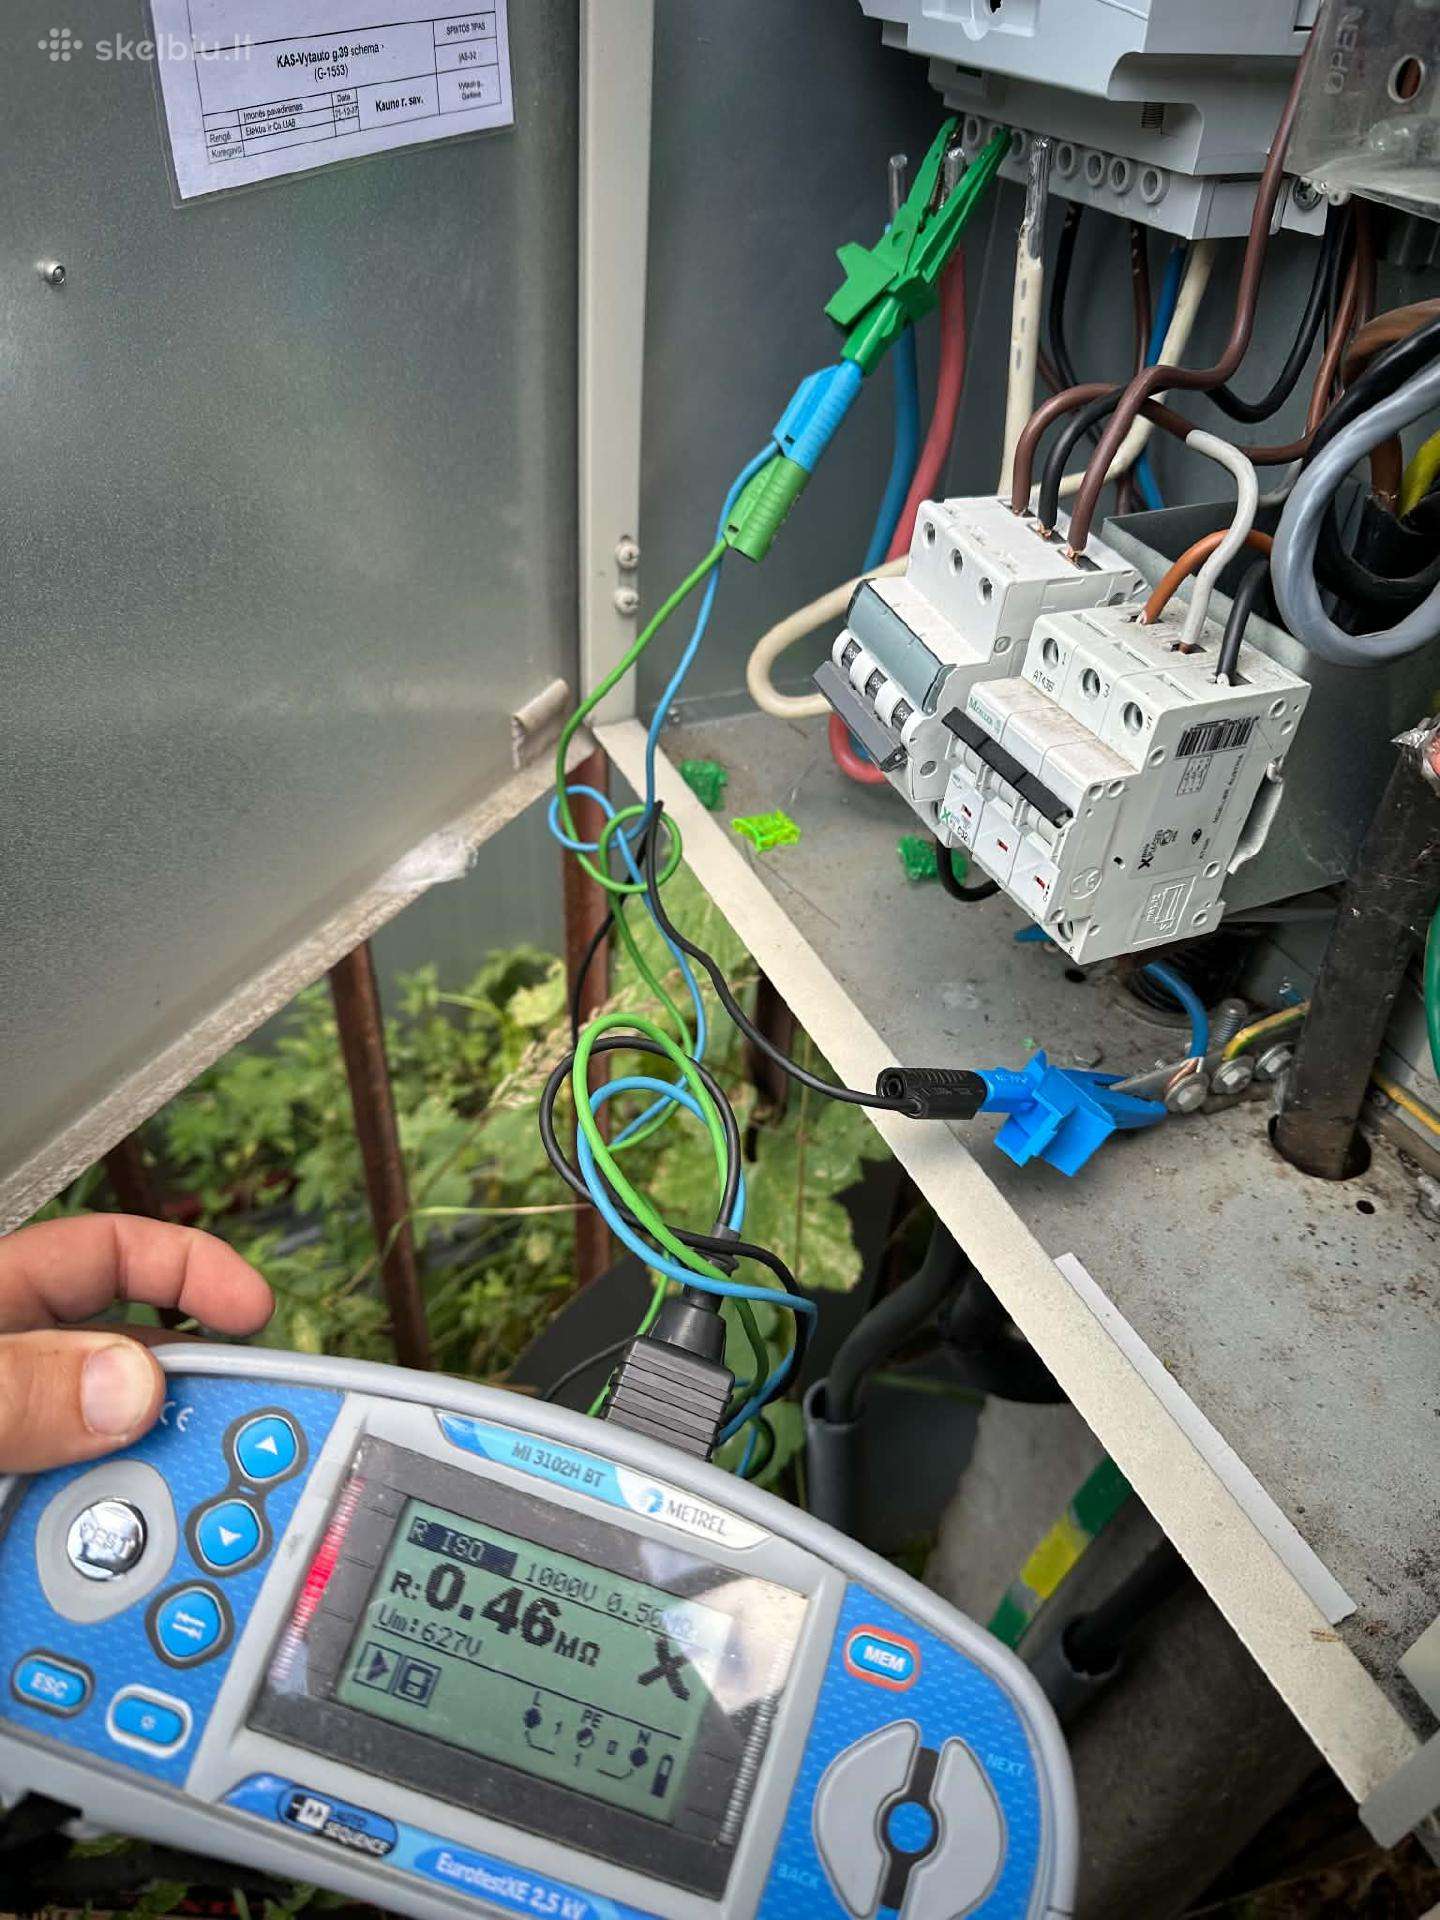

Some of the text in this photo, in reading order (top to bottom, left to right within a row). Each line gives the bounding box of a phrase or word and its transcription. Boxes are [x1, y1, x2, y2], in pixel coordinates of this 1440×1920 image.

[276, 51, 331, 68] KAS-Vytauto
[350, 43, 380, 56] schema
[314, 63, 349, 83] (G-1553)
[375, 96, 424, 112] Kauno r. sav.
[1104, 683, 1111, 698] 3
[512, 1441, 606, 1488] MI 3102H BT
[667, 1499, 728, 1536] METREL
[408, 1519, 428, 1544] R
[446, 1531, 484, 1561] ISO
[863, 1645, 906, 1672] MEM
[30, 1672, 68, 1698] ESC
[580, 1708, 604, 1729] PE
[986, 1752, 1027, 1777] NEXT
